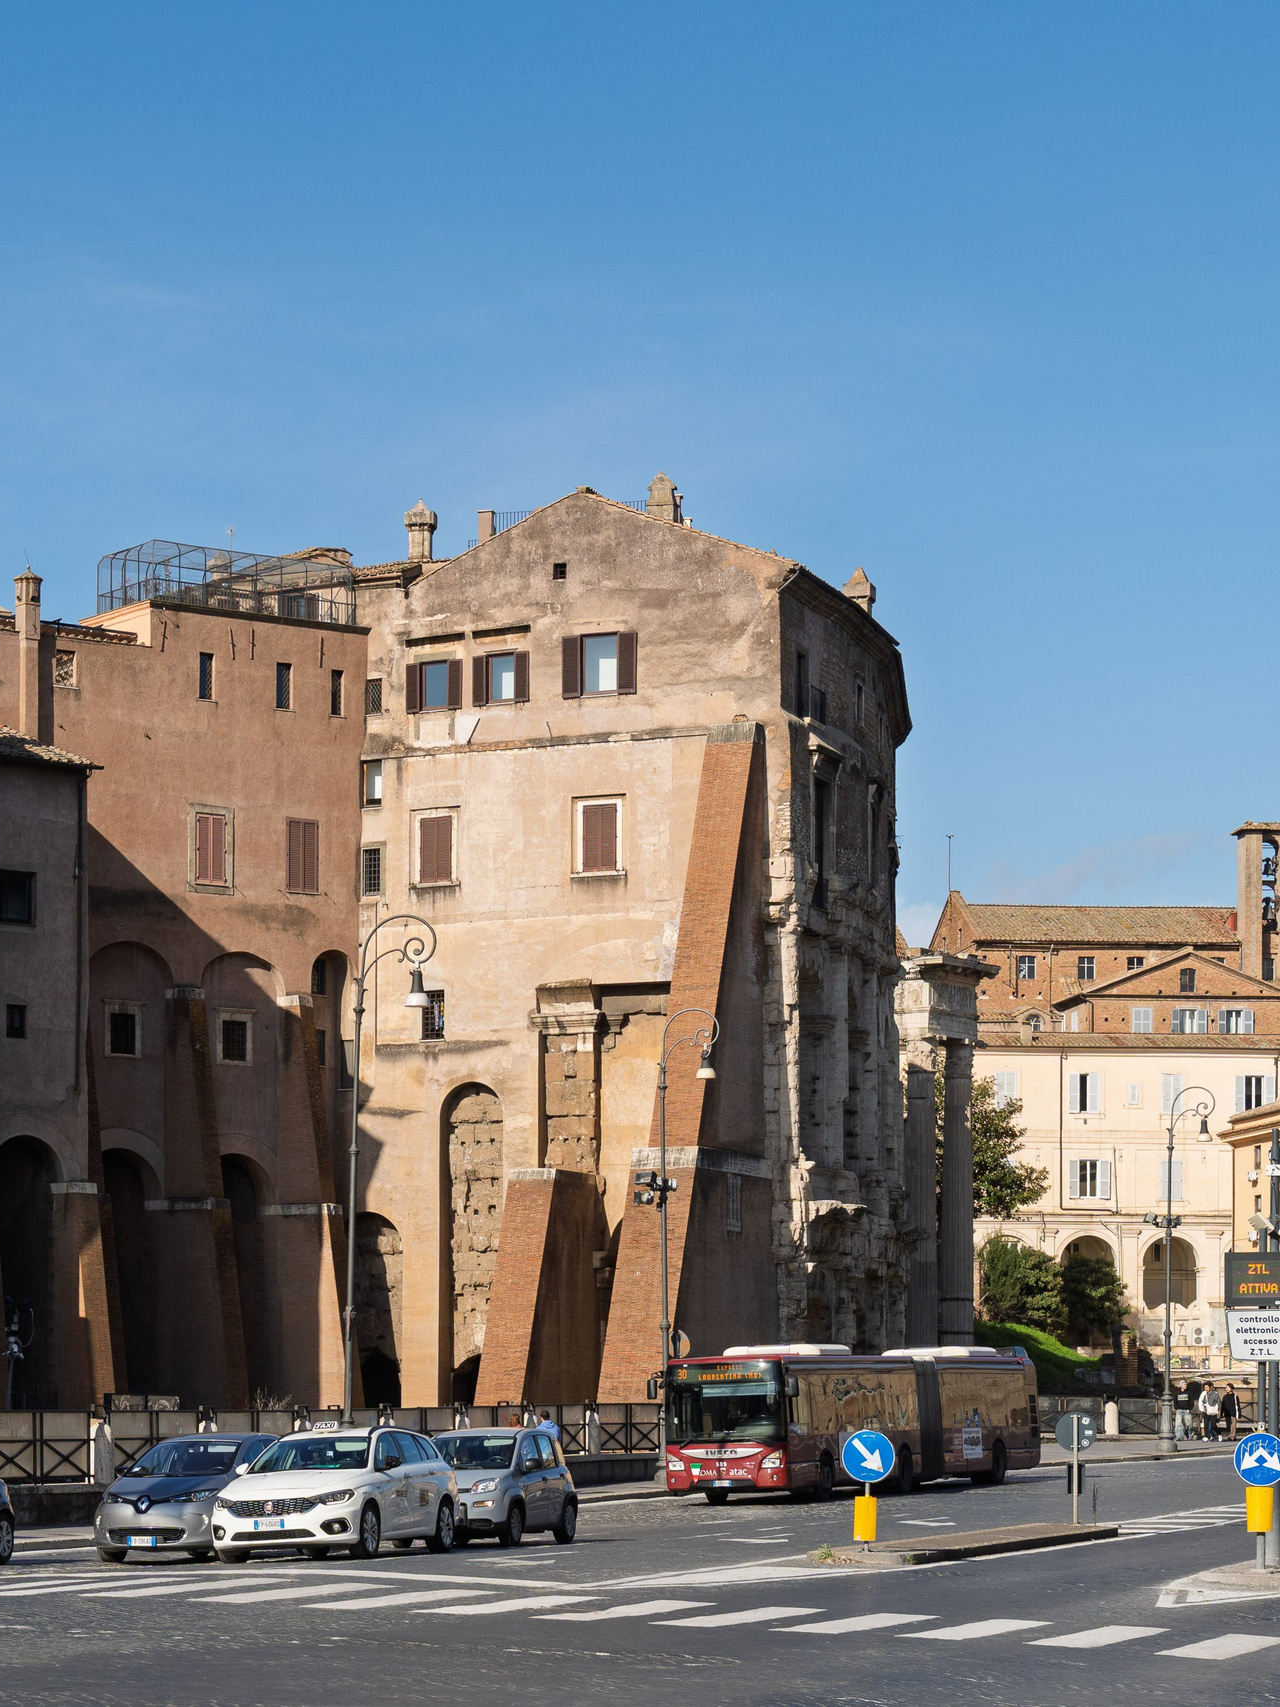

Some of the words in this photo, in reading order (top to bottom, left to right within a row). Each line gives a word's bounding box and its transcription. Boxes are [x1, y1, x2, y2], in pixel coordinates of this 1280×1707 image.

[1248, 1263, 1269, 1274] ZTL
[1239, 1283, 1279, 1294] ATTIVA
[1239, 1315, 1280, 1323] controllo
[1236, 1326, 1280, 1334] elettronic
[1250, 1348, 1275, 1356] Z.T.L.
[677, 1369, 688, 1380] 30
[698, 1373, 742, 1381] LAURENTINA
[705, 1449, 738, 1457] IVECO
[729, 1468, 748, 1476] atac
